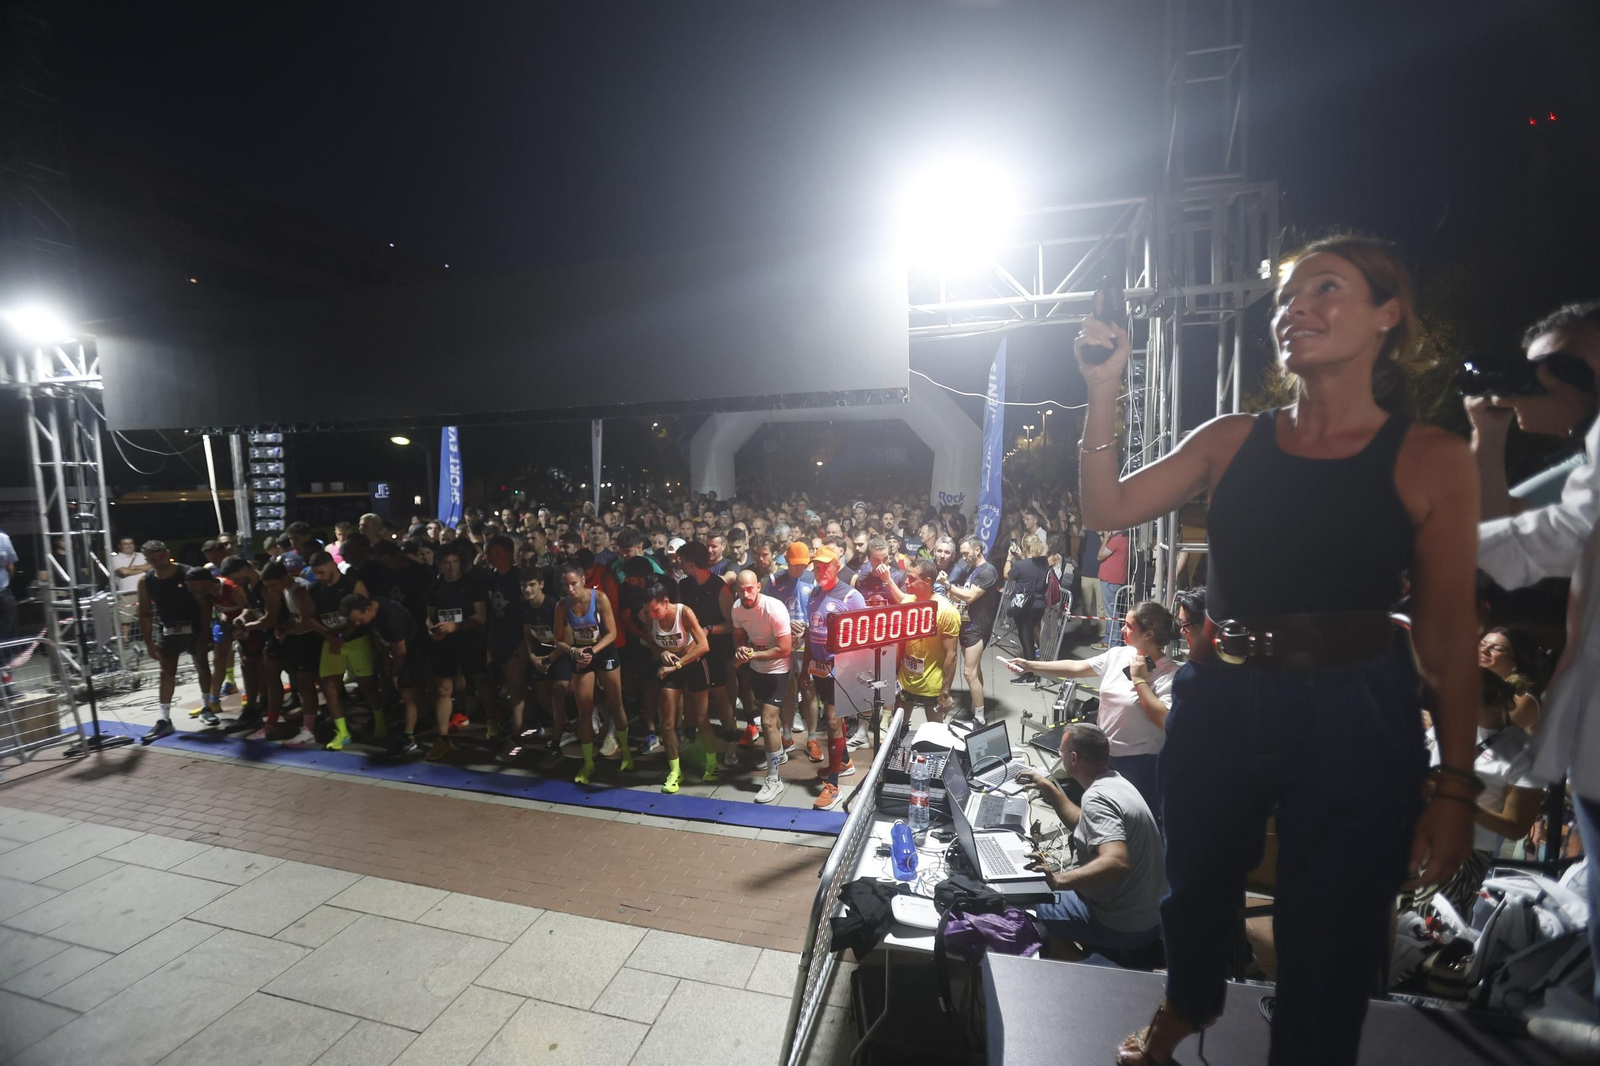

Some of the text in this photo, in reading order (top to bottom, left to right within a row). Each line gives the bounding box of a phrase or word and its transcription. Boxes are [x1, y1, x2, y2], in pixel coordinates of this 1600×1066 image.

[449, 455, 460, 505] SPORT
[939, 491, 966, 505] Rock
[839, 606, 933, 648] 000000
